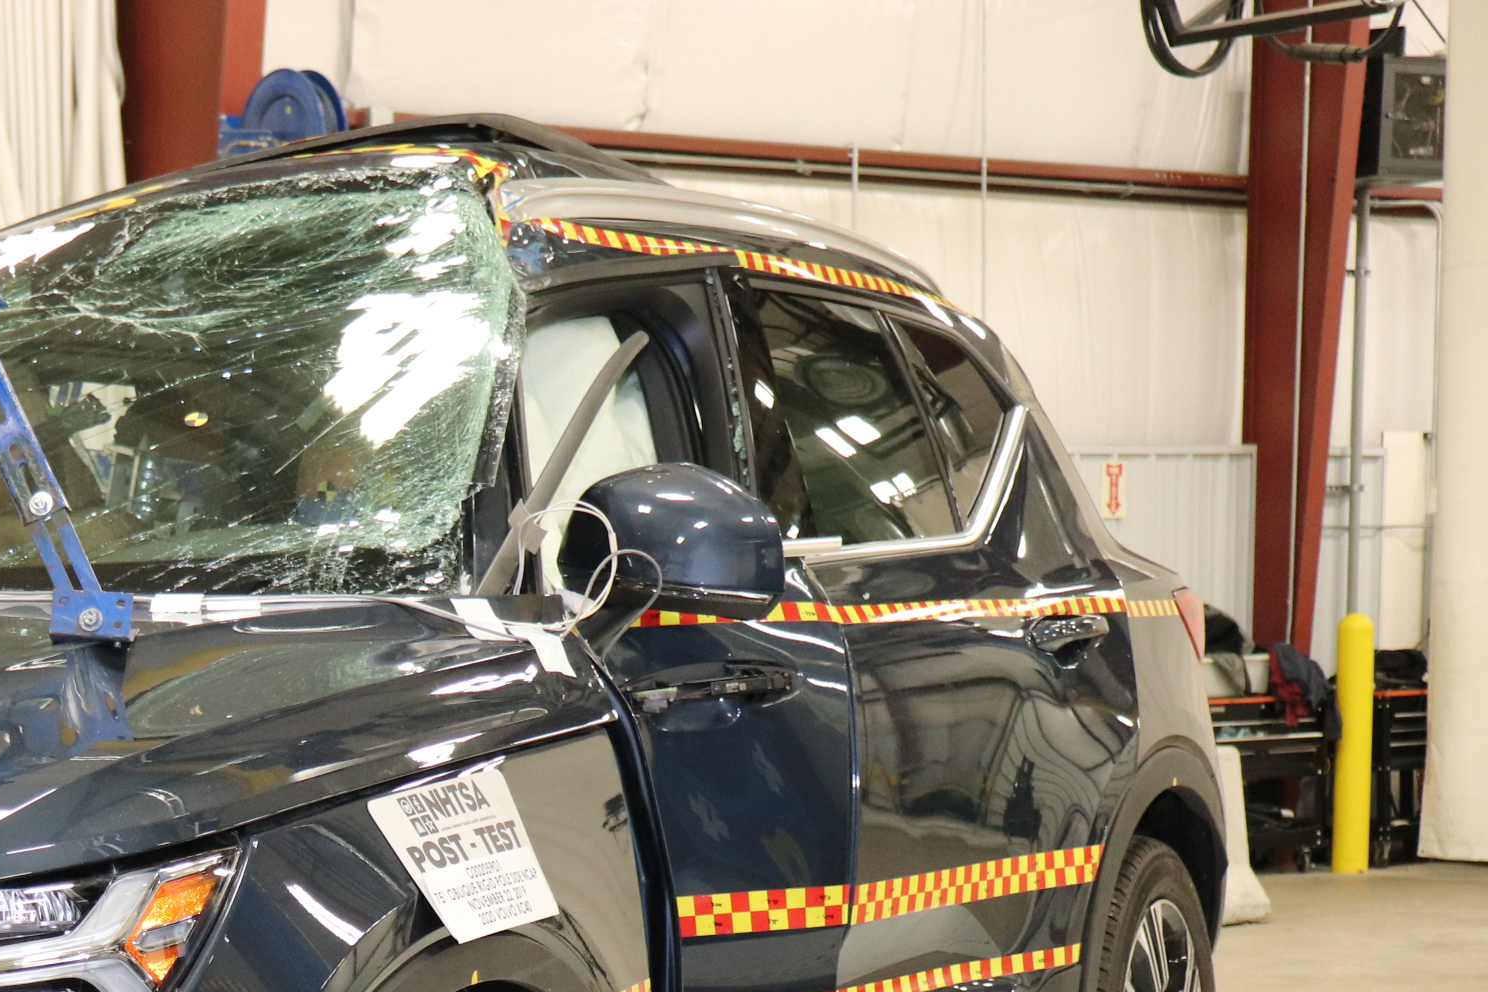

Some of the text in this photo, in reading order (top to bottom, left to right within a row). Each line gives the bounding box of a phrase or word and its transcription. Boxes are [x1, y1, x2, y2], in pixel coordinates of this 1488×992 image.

[420, 779, 491, 821] NHTSA
[405, 833, 470, 873] POST
[474, 820, 522, 855] TEST
[446, 882, 479, 901] OBLIQUE
[475, 877, 497, 893] RIGID
[494, 872, 513, 887] POLE
[508, 870, 524, 885] SIDE
[521, 867, 538, 881] NCAP
[467, 891, 506, 912] NOVEMBER
[512, 885, 528, 900] 2019
[477, 900, 533, 925] 2020 VOLVO XC40
